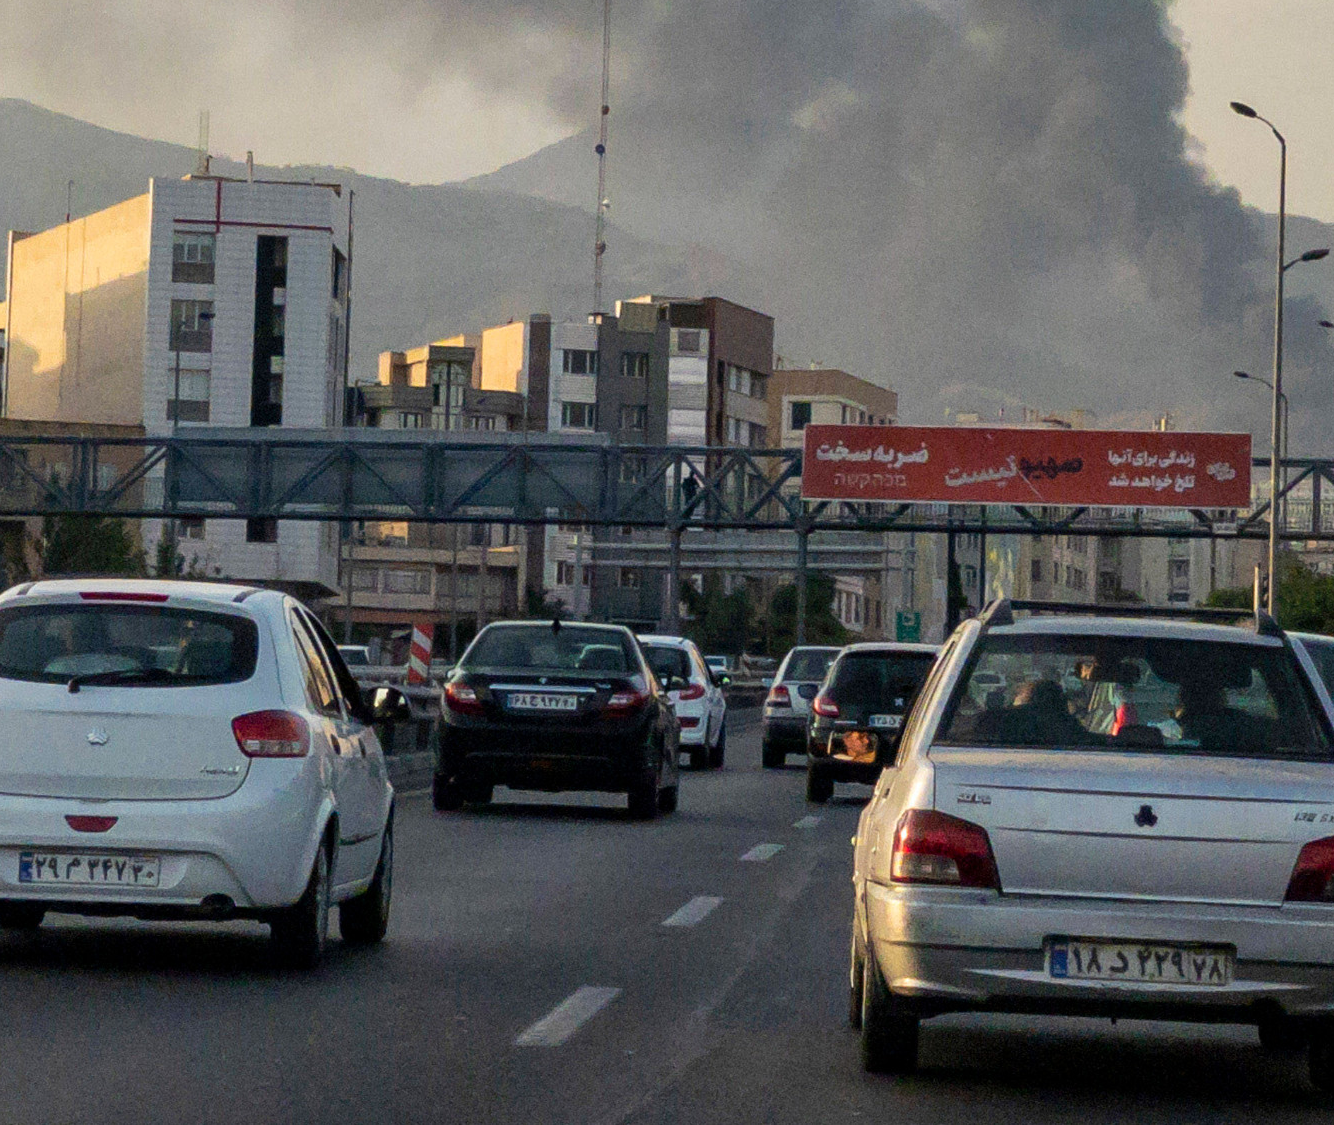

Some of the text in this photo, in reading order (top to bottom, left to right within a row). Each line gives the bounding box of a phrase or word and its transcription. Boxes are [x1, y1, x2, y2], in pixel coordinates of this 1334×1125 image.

[816, 439, 930, 468] ضربه سخت
[1107, 448, 1196, 469] زندگی برای آنها
[1107, 473, 1196, 493] تلخ خواهد شد
